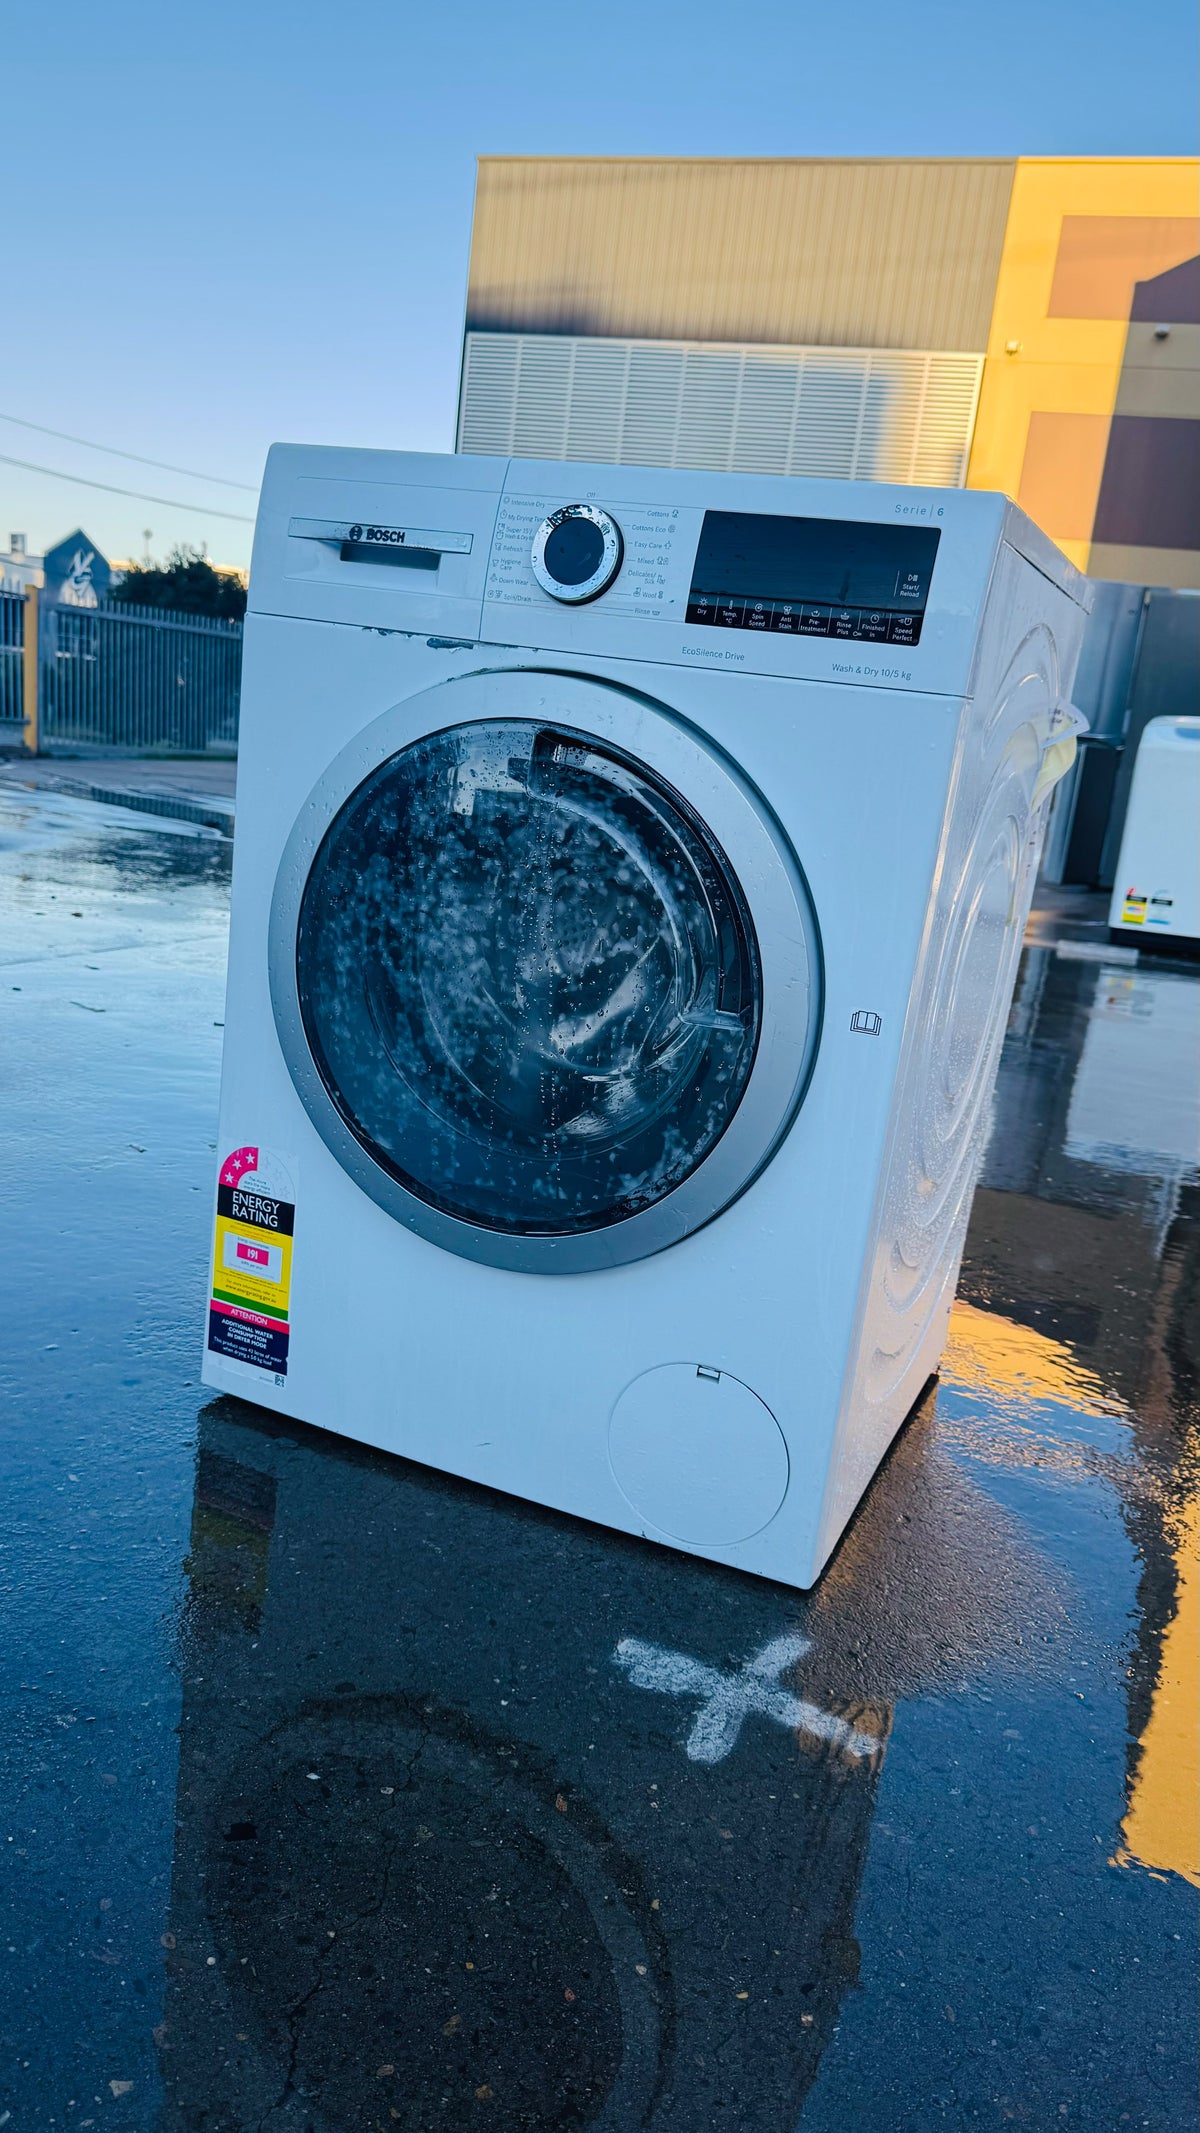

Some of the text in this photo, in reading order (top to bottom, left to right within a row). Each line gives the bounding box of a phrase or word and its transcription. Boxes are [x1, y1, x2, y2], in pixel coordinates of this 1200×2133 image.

[895, 504, 944, 516] Serie 6
[366, 528, 406, 543] BOSCH
[634, 541, 648, 549] Easy
[682, 646, 745, 661] EcoSilence Drive
[832, 664, 854, 673] Wash
[864, 667, 879, 677] Dry
[881, 669, 899, 678] 10/5
[901, 671, 912, 681] kg
[233, 1191, 280, 1214] ENERGY
[232, 1204, 278, 1228] RATING
[247, 1248, 258, 1260] 191
[231, 1308, 268, 1326] ATTENTION
[222, 1318, 273, 1339] ADDITIONAL WATER
[228, 1327, 267, 1343] CONSUMPTION
[251, 1340, 267, 1349] MODE
